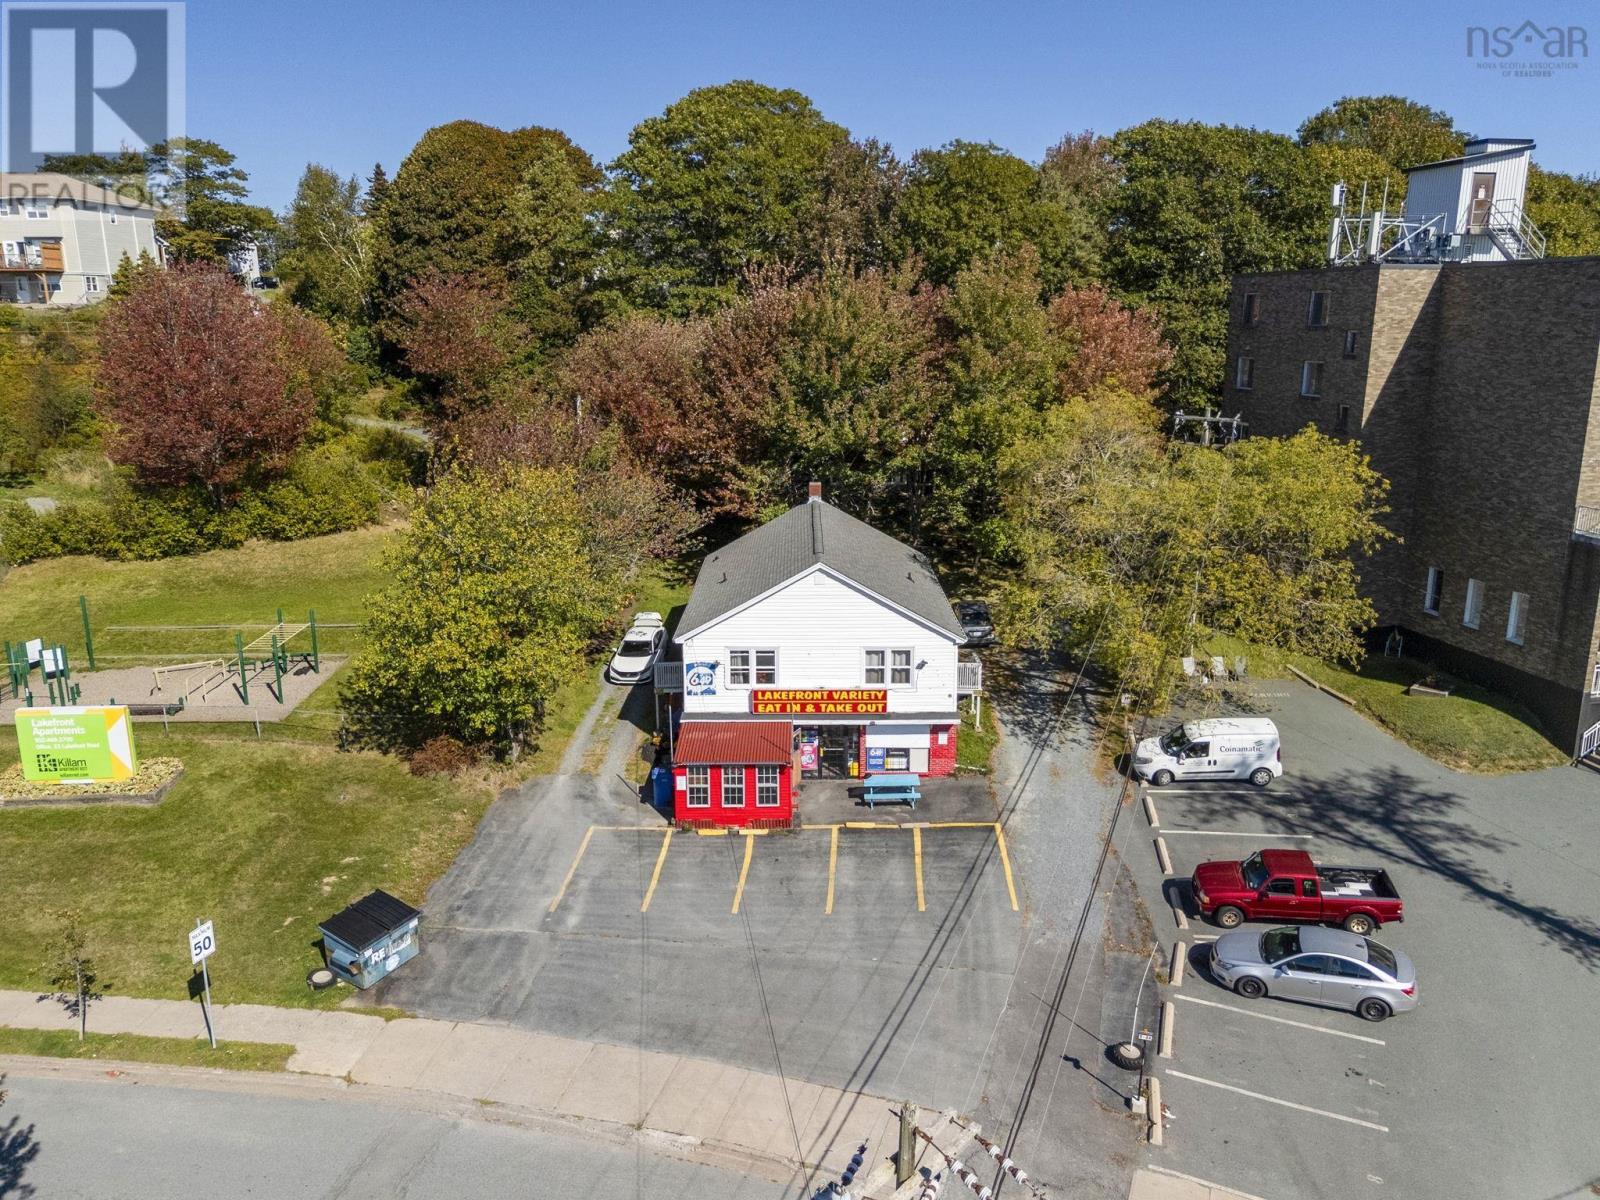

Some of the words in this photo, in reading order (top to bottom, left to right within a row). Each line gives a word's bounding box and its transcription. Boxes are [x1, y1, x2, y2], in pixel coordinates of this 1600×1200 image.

[758, 691, 829, 700] LAKEFRONT
[832, 690, 885, 700] VARIETY
[758, 703, 782, 713] EAT
[786, 703, 801, 713] IN
[805, 703, 816, 713] &
[819, 703, 853, 713] TAKE
[857, 703, 885, 713] OUT
[31, 718, 75, 727] Lakefront
[33, 727, 86, 736] Apartments
[1220, 745, 1263, 753] Coinamatic
[58, 758, 87, 767] Killam
[194, 935, 211, 956] 50
